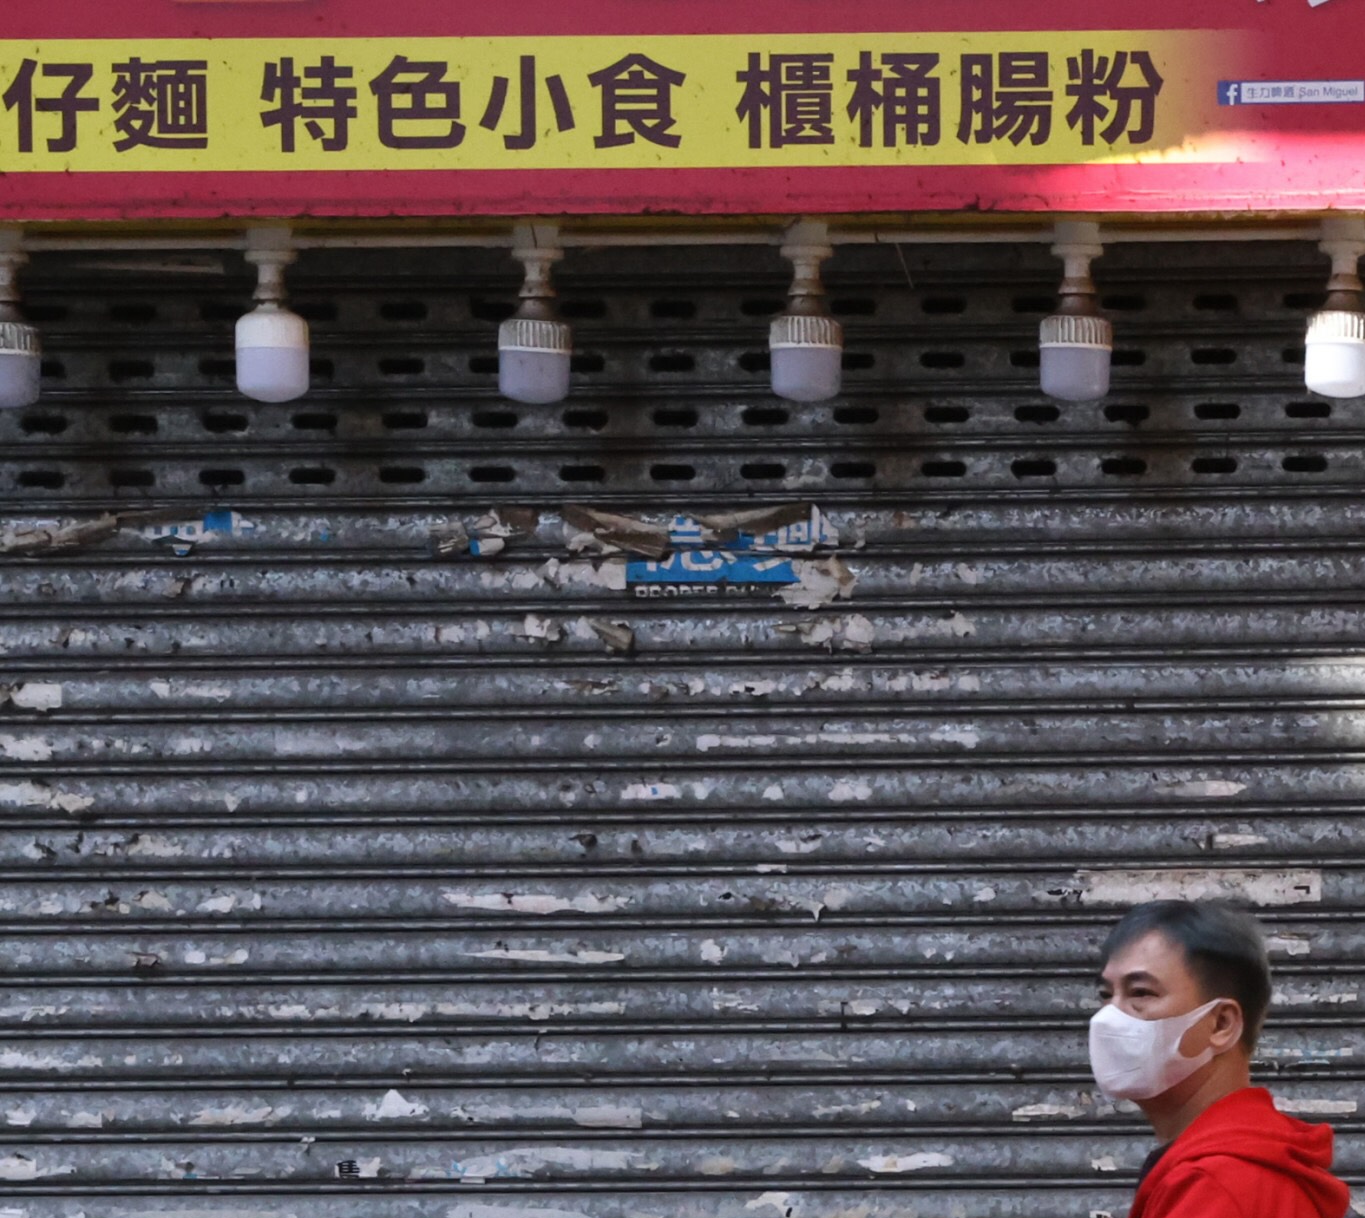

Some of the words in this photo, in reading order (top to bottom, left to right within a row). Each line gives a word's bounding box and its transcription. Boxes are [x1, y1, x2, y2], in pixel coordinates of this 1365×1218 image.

[2, 57, 208, 153] 仔麵
[259, 53, 685, 152] 特色小食
[736, 49, 1164, 148] 櫃桶腸粉
[1298, 86, 1321, 99] San
[1323, 86, 1358, 99] Miguel
